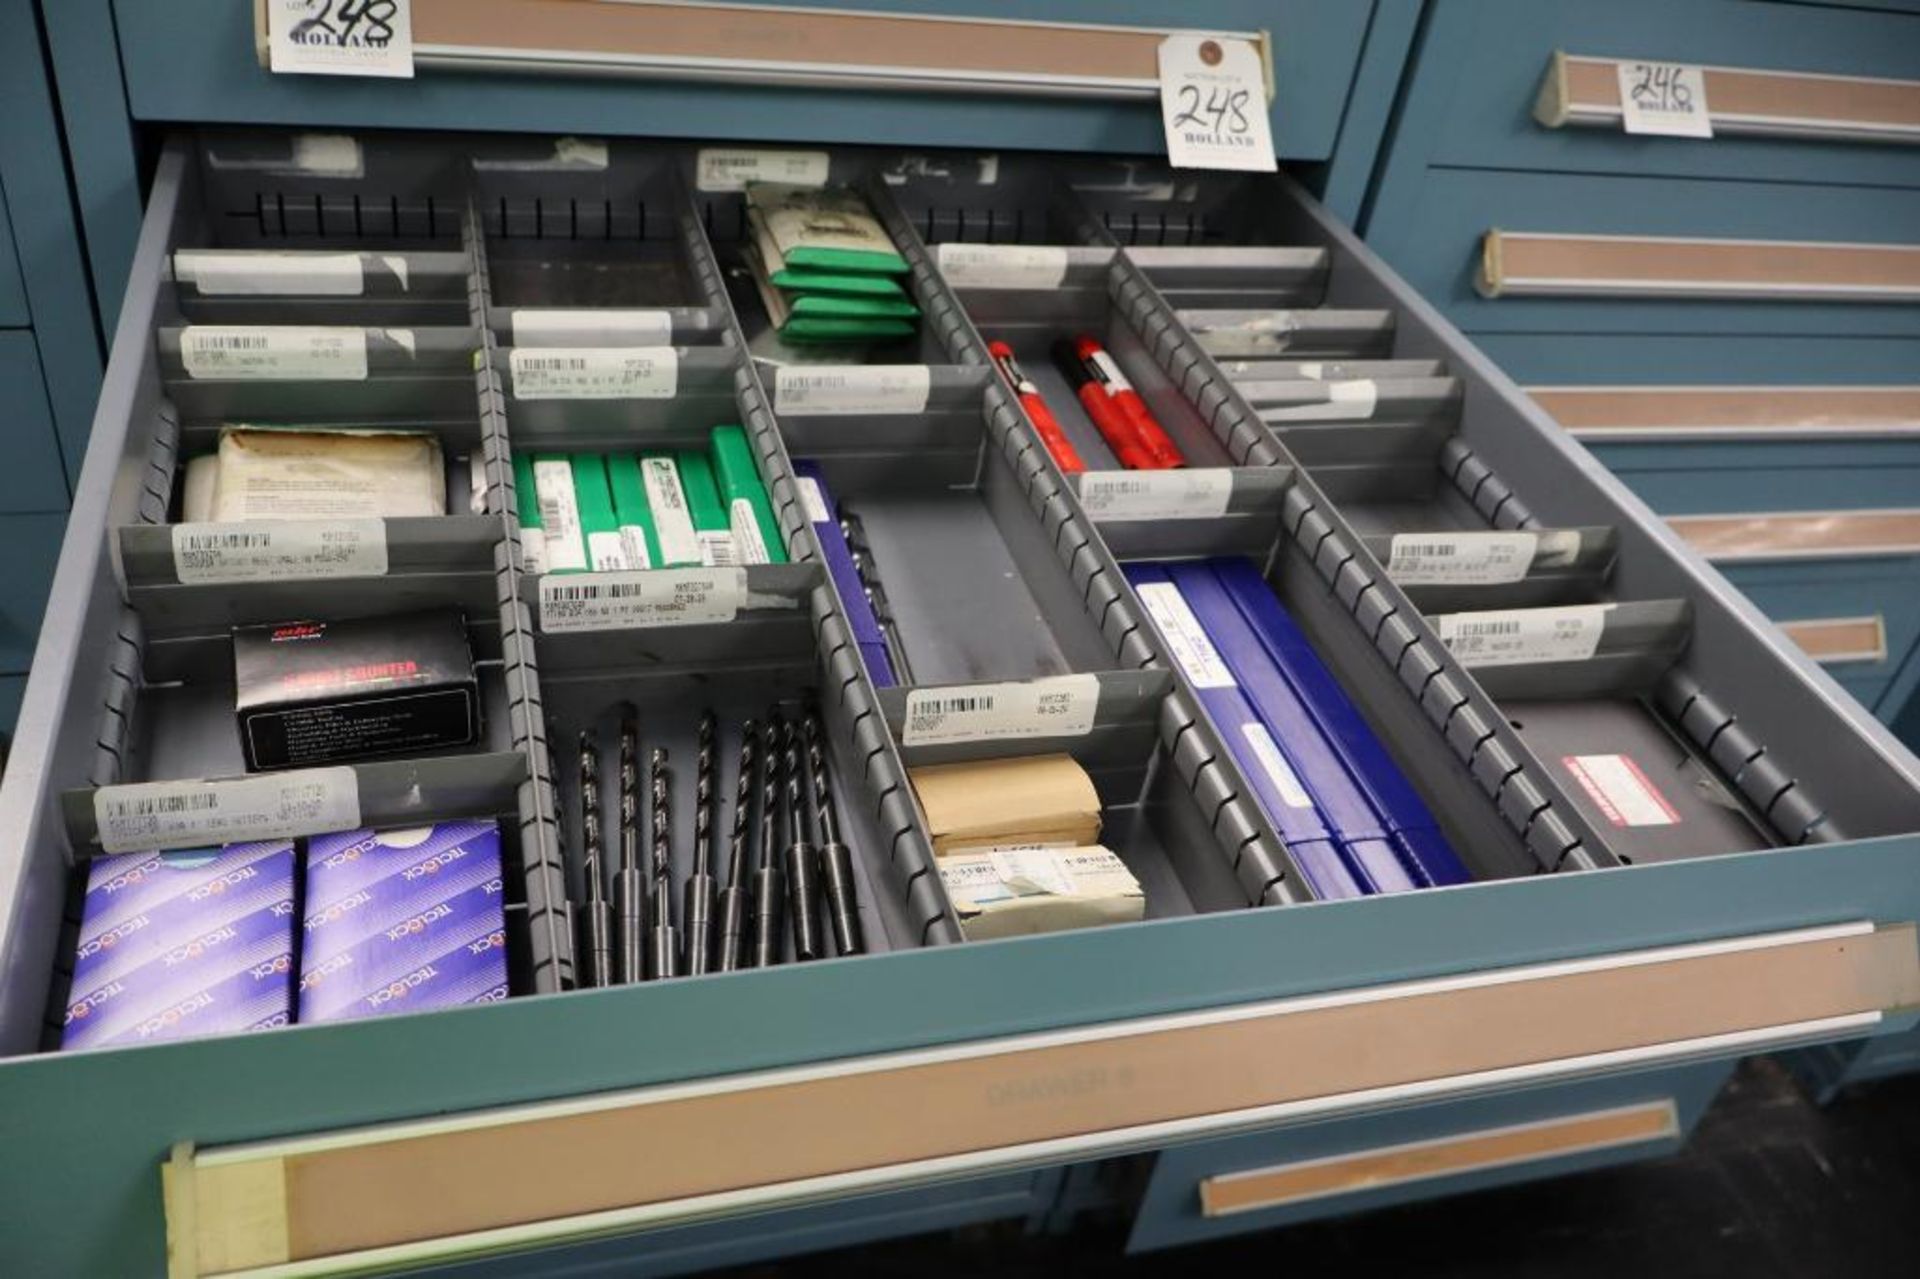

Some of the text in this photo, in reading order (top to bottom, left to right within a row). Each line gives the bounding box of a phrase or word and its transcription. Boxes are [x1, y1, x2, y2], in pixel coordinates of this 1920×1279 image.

[290, 0, 398, 47] 248
[1174, 85, 1249, 133] 248
[1631, 64, 1692, 111] 246
[1184, 132, 1255, 147] HOLLAND
[187, 866, 259, 903] TECLOCK
[402, 847, 469, 882] TECLOCK
[305, 890, 372, 931] TECLOCK
[385, 904, 454, 941] TECLOCK
[76, 911, 151, 960] TECLOCK
[162, 924, 237, 968] TECLOCK
[367, 965, 439, 1008] TECLOCK
[135, 992, 214, 1037] TECLOCK
